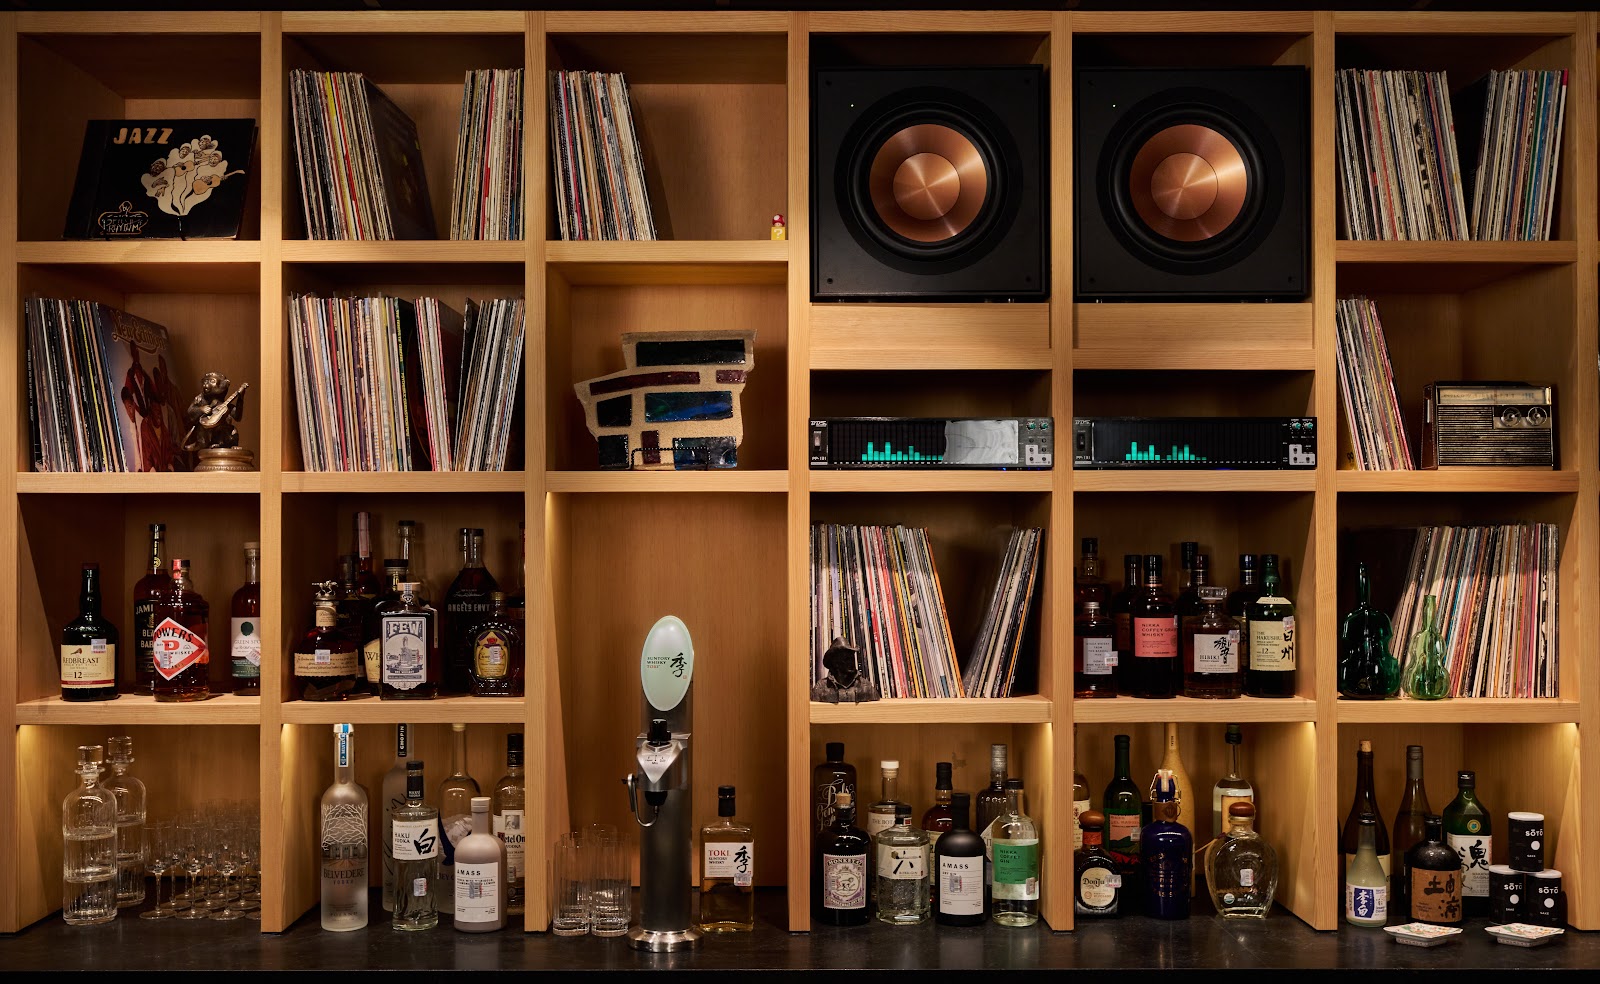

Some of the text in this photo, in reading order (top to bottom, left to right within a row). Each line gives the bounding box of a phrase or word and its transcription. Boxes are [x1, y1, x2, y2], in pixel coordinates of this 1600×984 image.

[113, 127, 173, 145] JAZZ
[122, 205, 129, 216] by
[109, 309, 167, 350] New Edition
[473, 603, 490, 612] ENVY
[388, 621, 421, 637] FEW
[62, 656, 99, 664] REDBREAST
[669, 652, 687, 678] 季
[74, 671, 83, 679] 12
[413, 828, 436, 856] 白
[733, 845, 751, 874] 季
[942, 862, 969, 870] AMASS
[323, 867, 365, 880] BELVEDERE
[457, 868, 481, 876] AMASS
